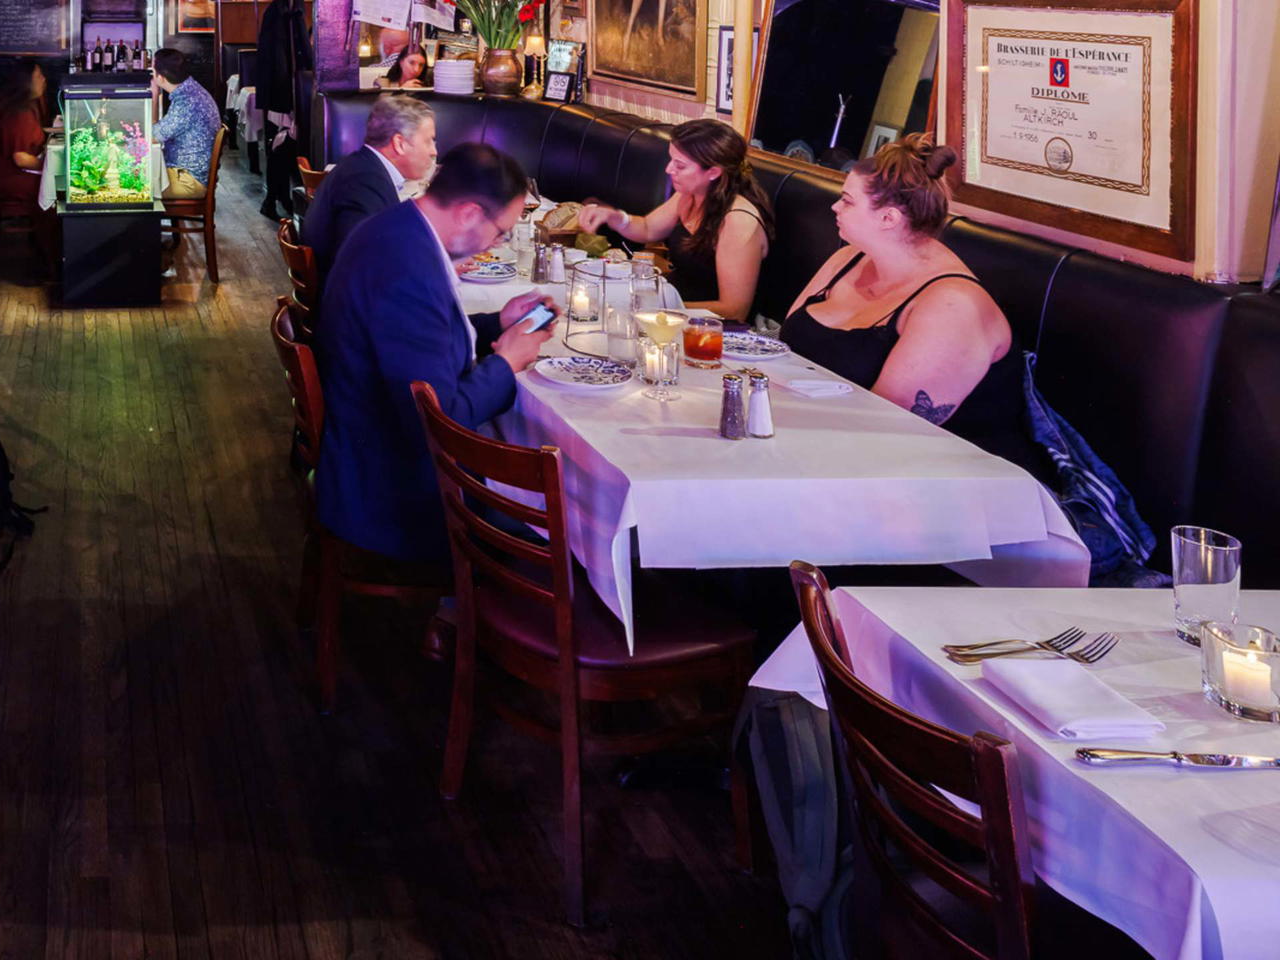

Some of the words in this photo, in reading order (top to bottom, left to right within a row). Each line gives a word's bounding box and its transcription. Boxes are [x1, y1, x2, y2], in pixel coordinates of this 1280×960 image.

[997, 42, 1045, 57] BRASSERIE
[1031, 86, 1088, 101] DIPLÔME
[1023, 114, 1064, 127] ALTKIRCH
[1051, 108, 1078, 121] RAOUL
[1087, 130, 1098, 140] 30
